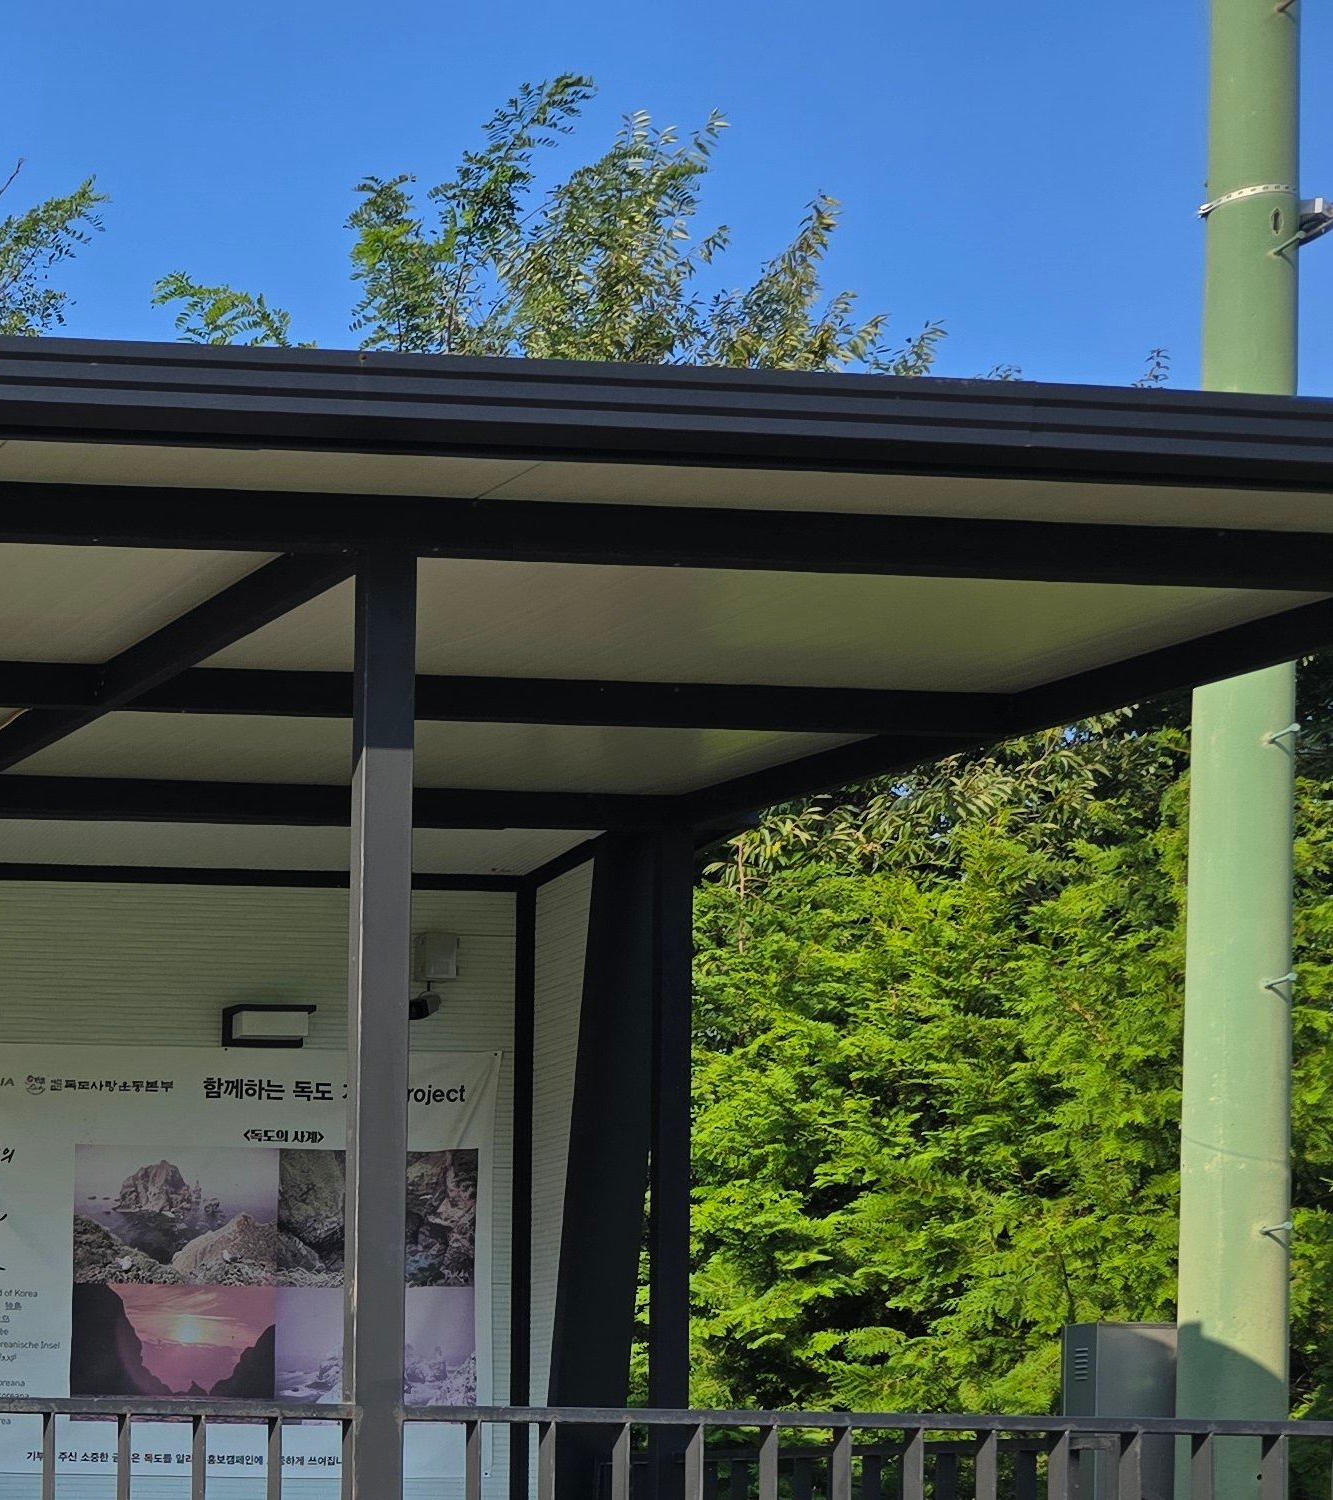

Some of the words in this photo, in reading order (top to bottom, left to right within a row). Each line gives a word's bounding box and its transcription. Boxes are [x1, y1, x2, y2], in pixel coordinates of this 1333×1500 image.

[203, 1077, 286, 1101] 함께하는
[292, 1081, 334, 1102] 독도
[406, 1084, 466, 1106] roject
[4, 1288, 13, 1298] of
[14, 1289, 39, 1298] Korea
[40, 1340, 61, 1350] Insel
[58, 1451, 77, 1462] 주신
[80, 1452, 109, 1463] 소중한
[144, 1453, 173, 1464] 독도를
[206, 1454, 264, 1466] 홍보캠페인에
